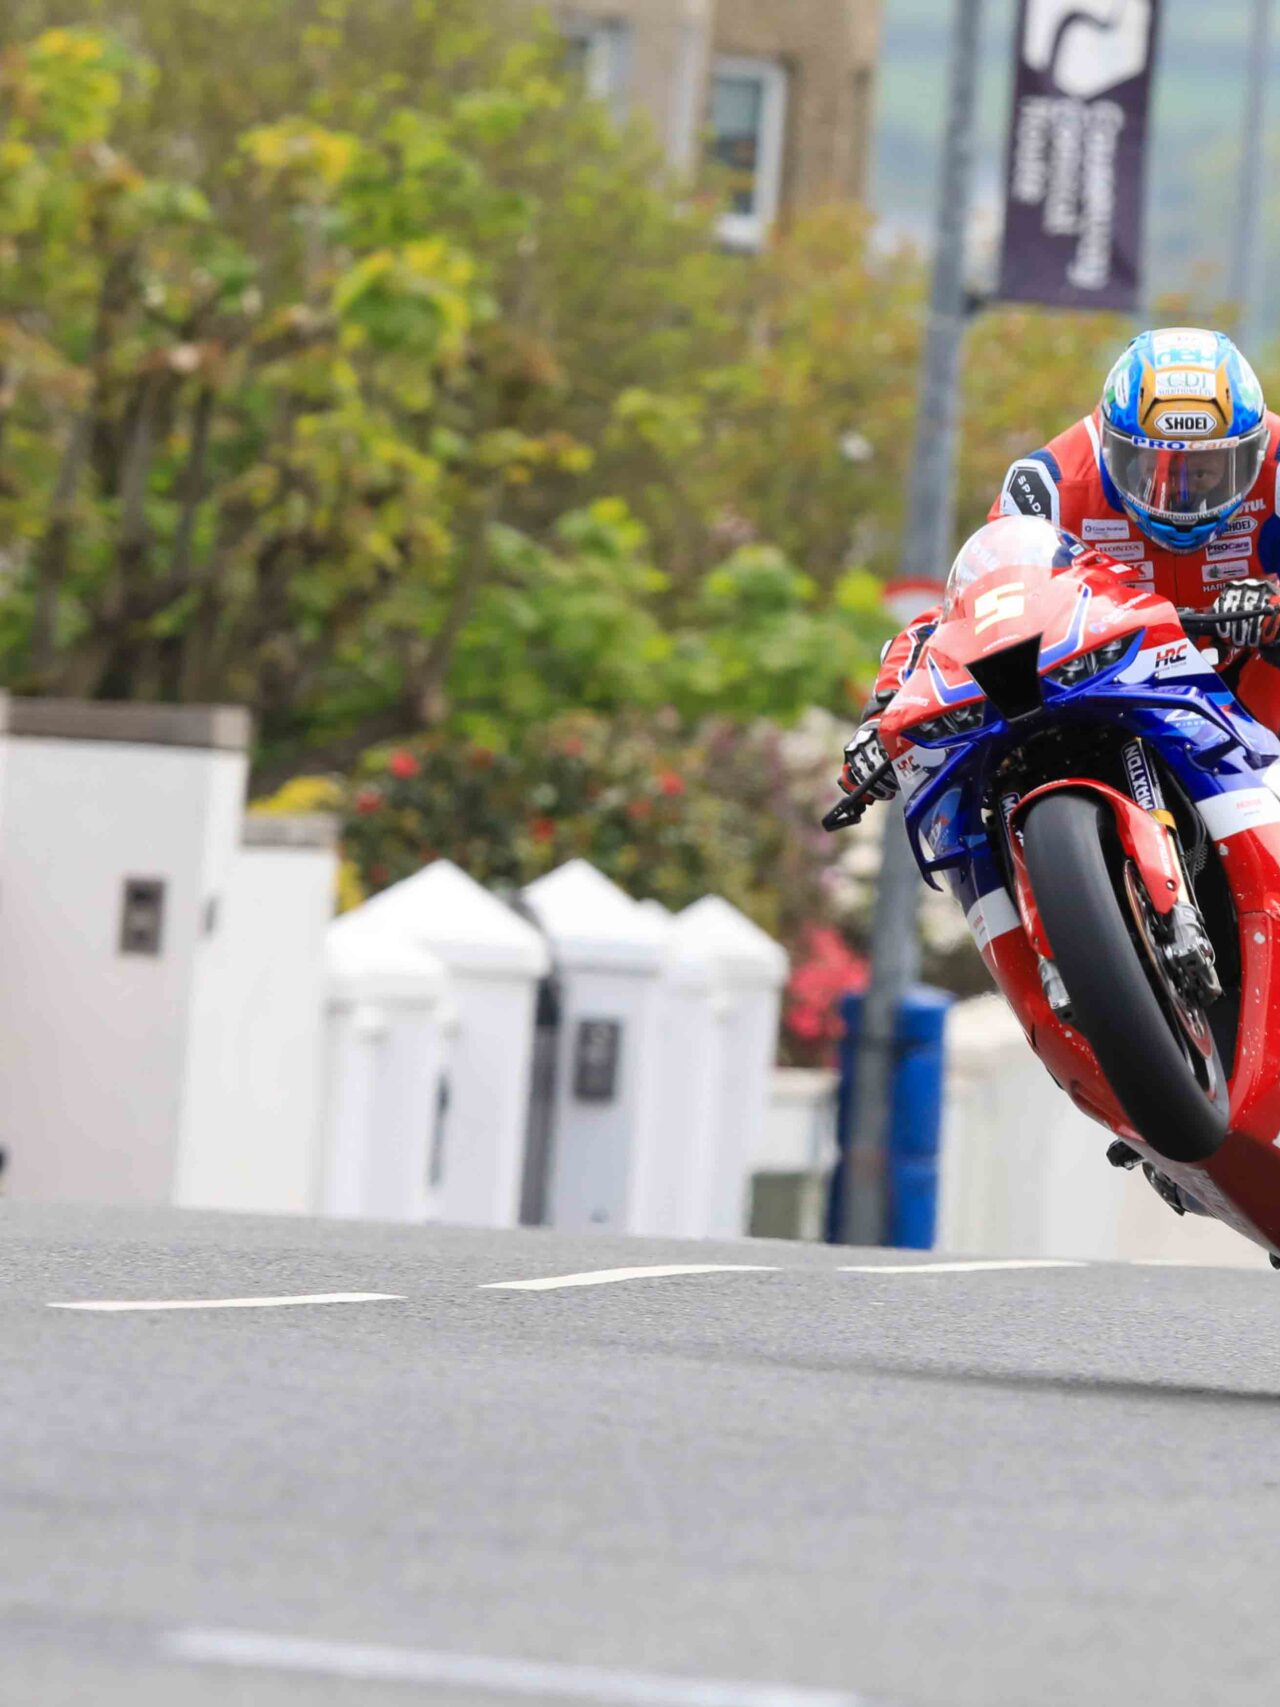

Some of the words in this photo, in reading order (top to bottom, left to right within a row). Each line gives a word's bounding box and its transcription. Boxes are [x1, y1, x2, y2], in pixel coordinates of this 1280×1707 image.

[1164, 416, 1208, 430] SHOEI
[1240, 499, 1266, 513] TUL
[975, 582, 1024, 635] 5
[1155, 644, 1187, 668] HRC
[1124, 744, 1154, 811] MAXTON
